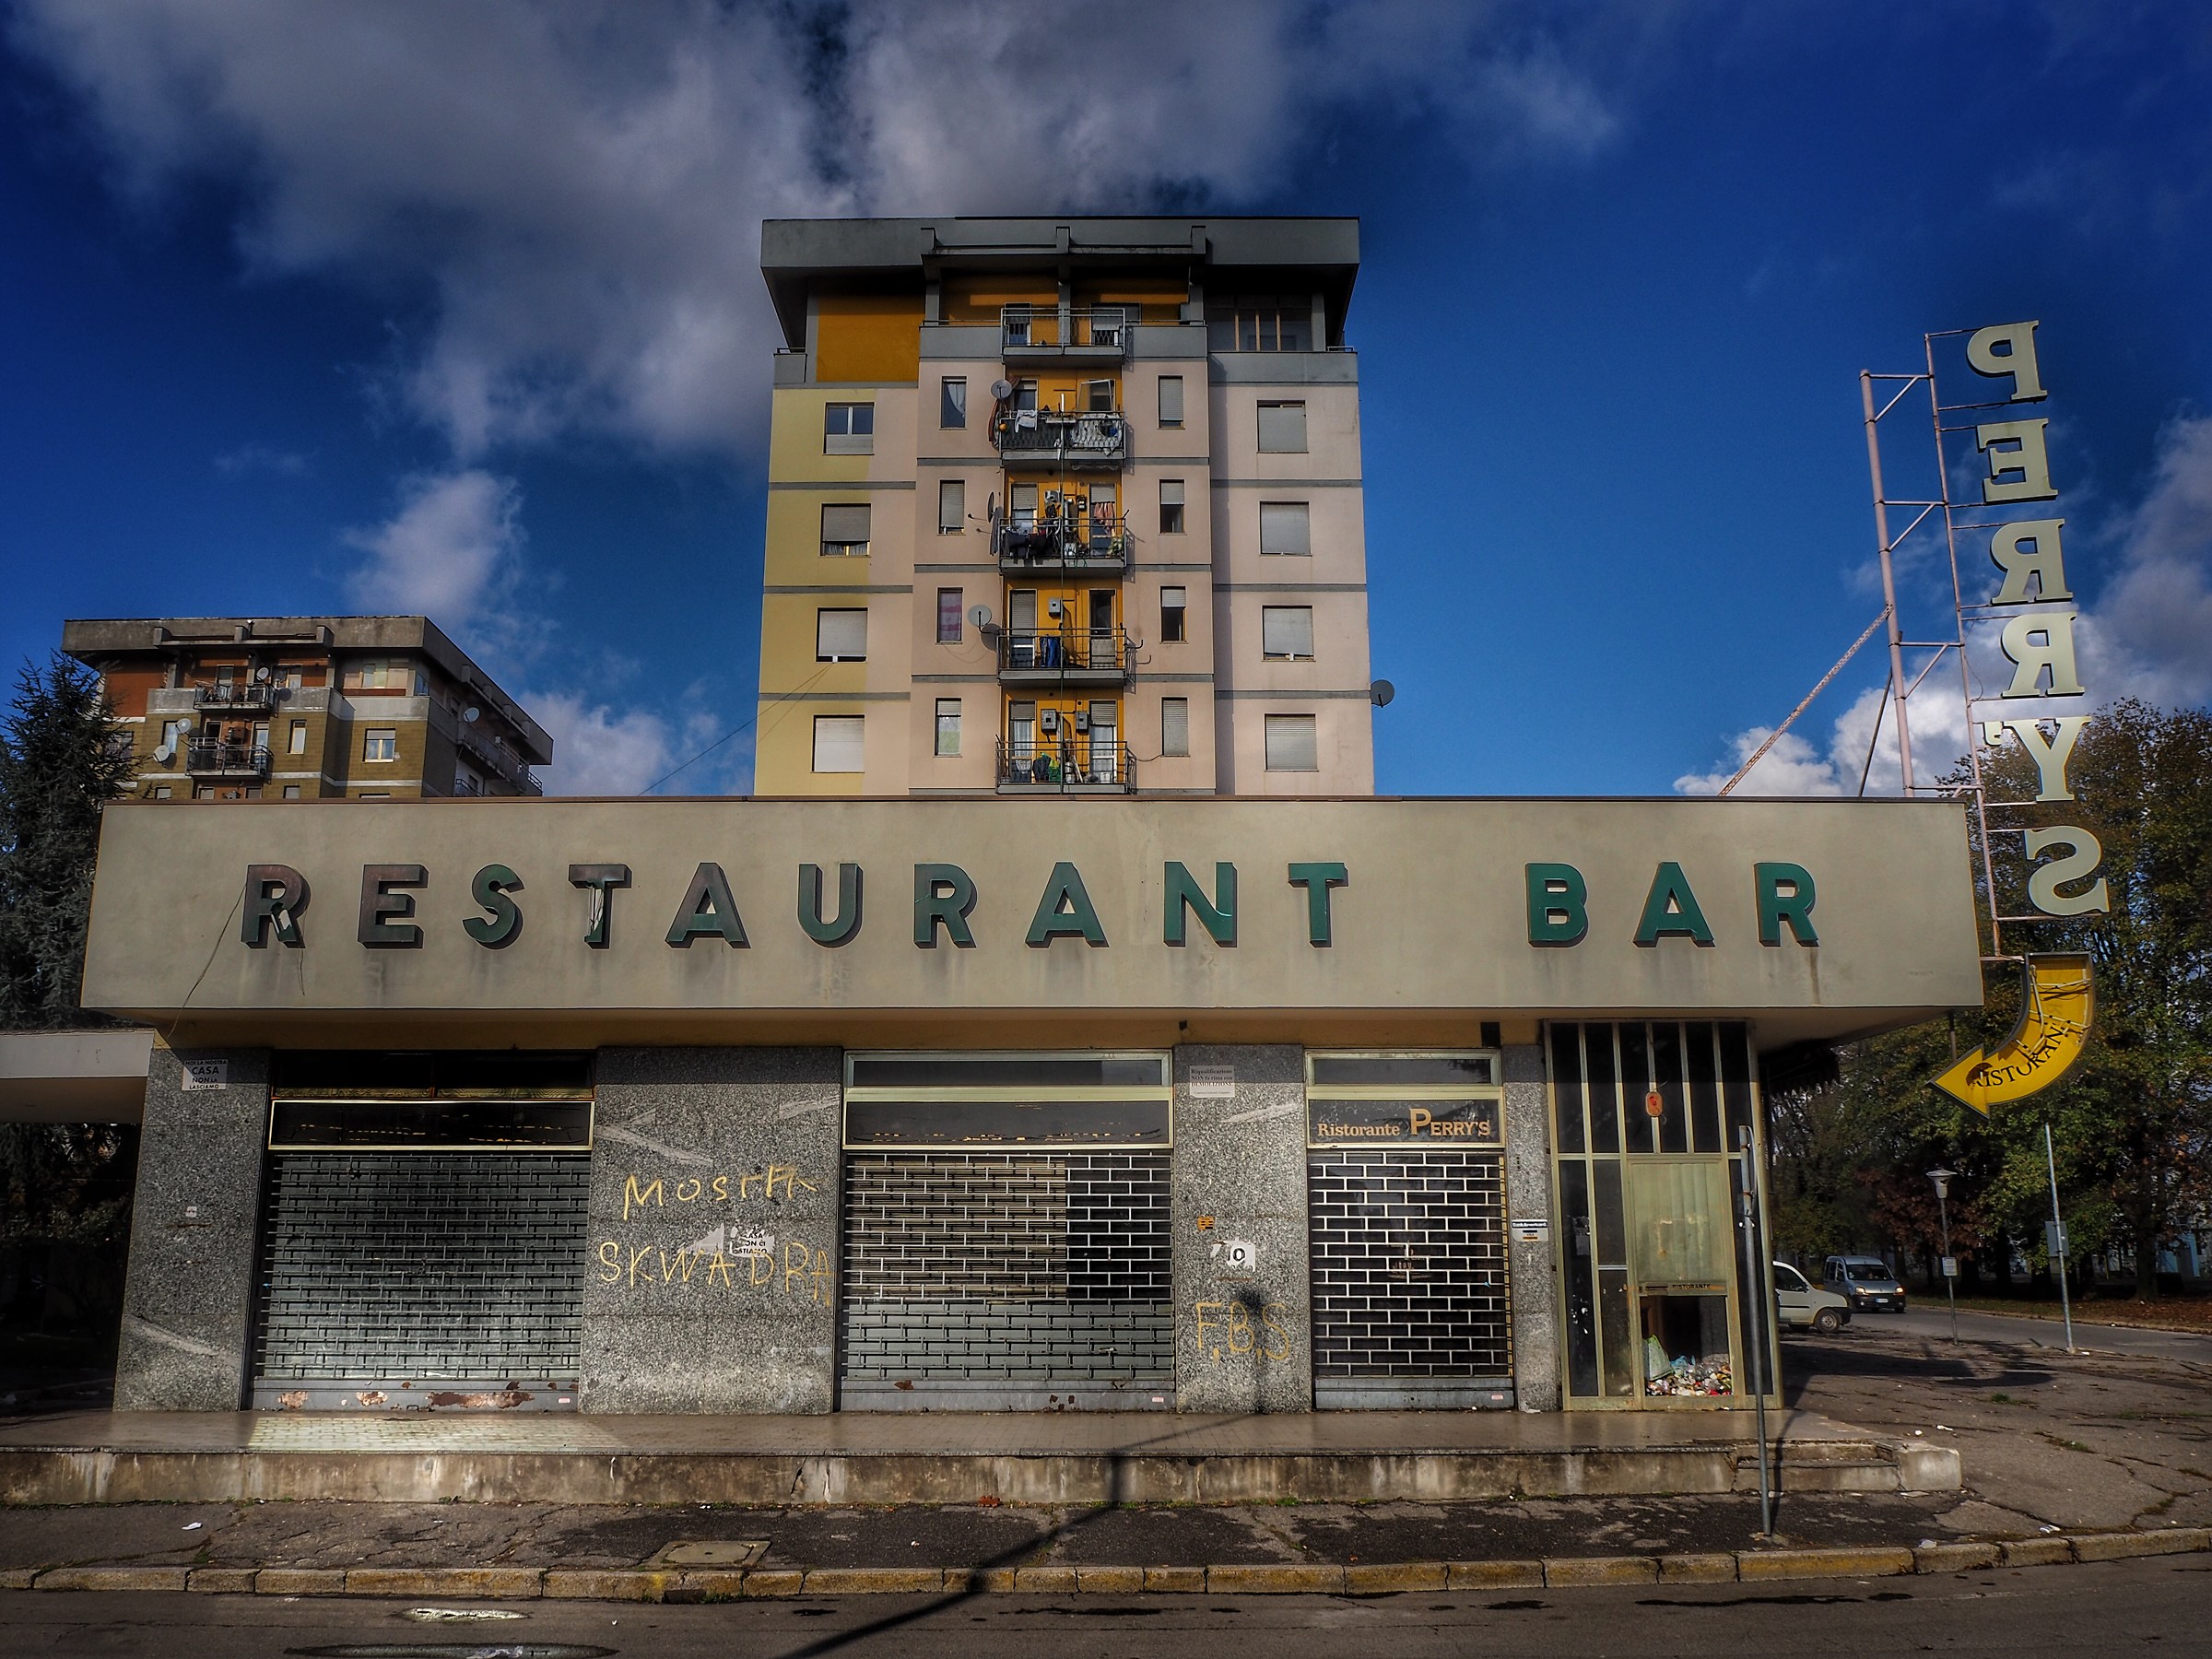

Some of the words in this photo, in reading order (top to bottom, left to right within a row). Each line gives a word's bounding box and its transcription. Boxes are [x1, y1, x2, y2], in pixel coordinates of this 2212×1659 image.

[241, 861, 1348, 949] RESTAURANT
[1524, 861, 1819, 947] BAR
[192, 1066, 219, 1075] CASA
[1317, 1123, 1401, 1136] Ristorante
[1409, 1108, 1490, 1136] PERRY'S
[599, 1241, 833, 1307] SKWADRA
